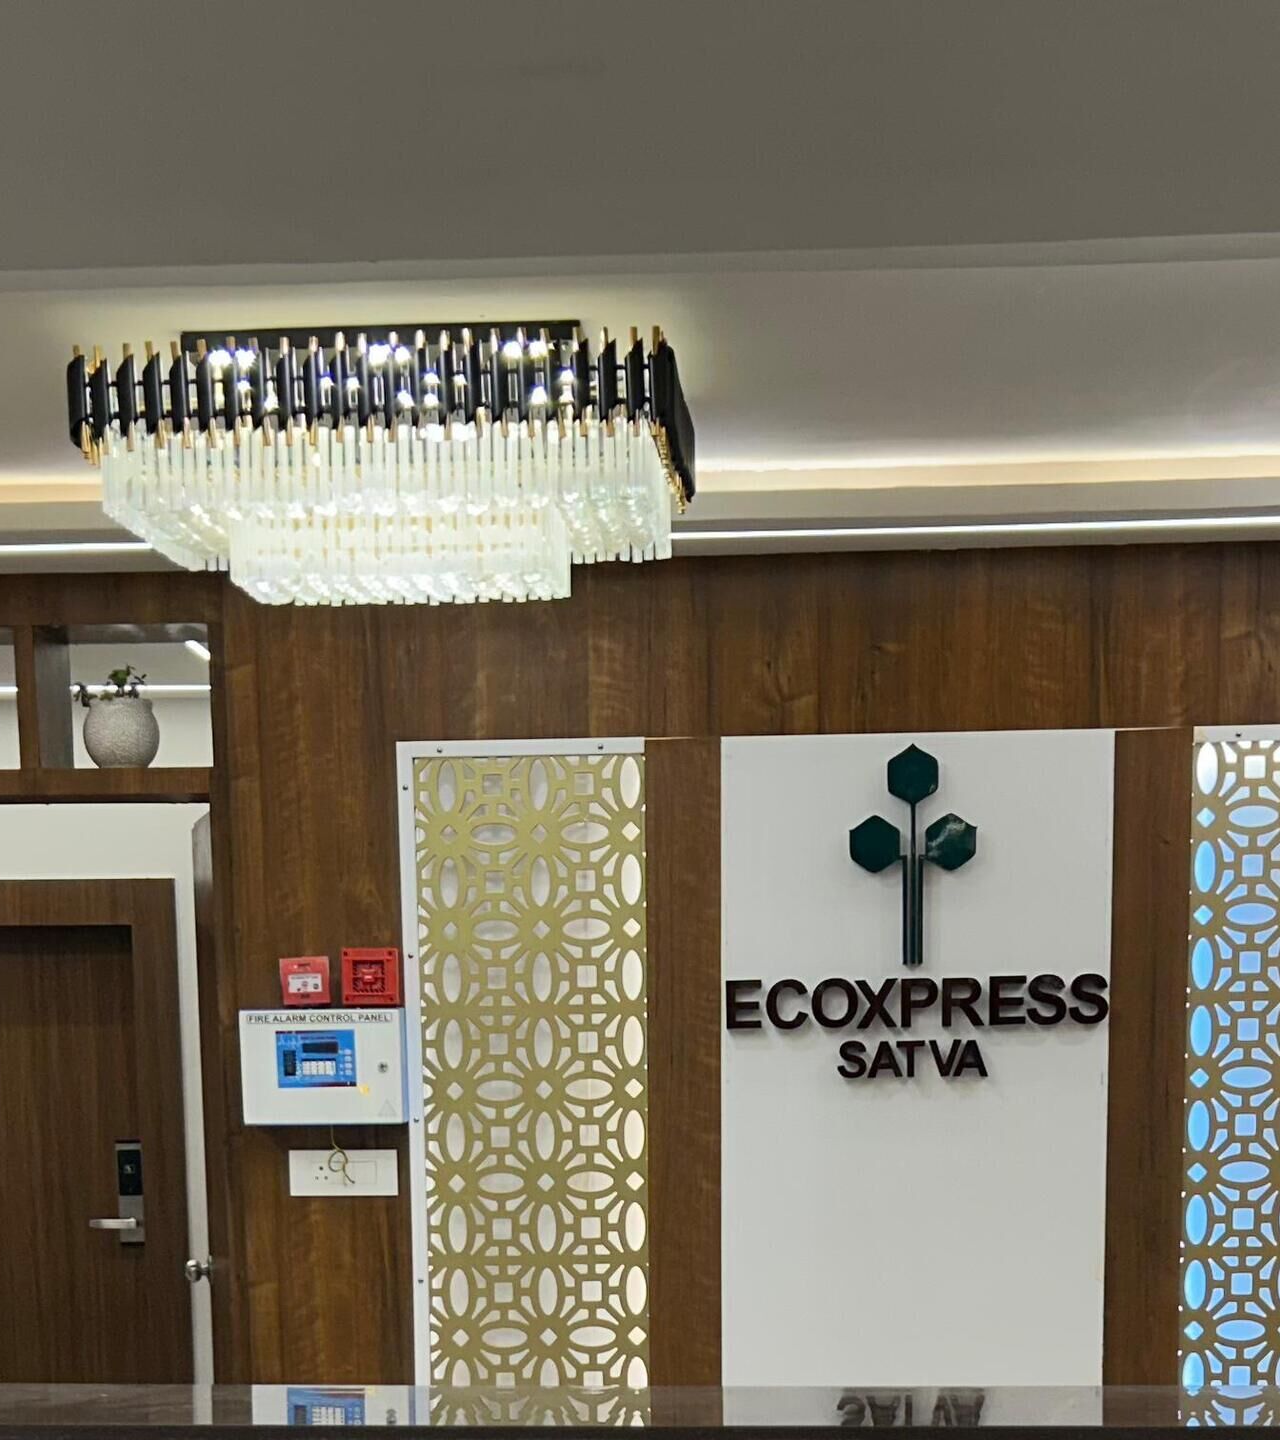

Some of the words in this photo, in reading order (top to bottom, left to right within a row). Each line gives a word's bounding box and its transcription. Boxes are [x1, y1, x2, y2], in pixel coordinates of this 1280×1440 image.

[248, 1014, 270, 1023] FIRE
[272, 1013, 306, 1023] ALARM
[309, 1013, 356, 1023] CONTROL
[358, 1012, 388, 1022] PANEL
[725, 973, 1109, 1030] ECOXPRESS
[837, 1039, 988, 1078] SATVA
